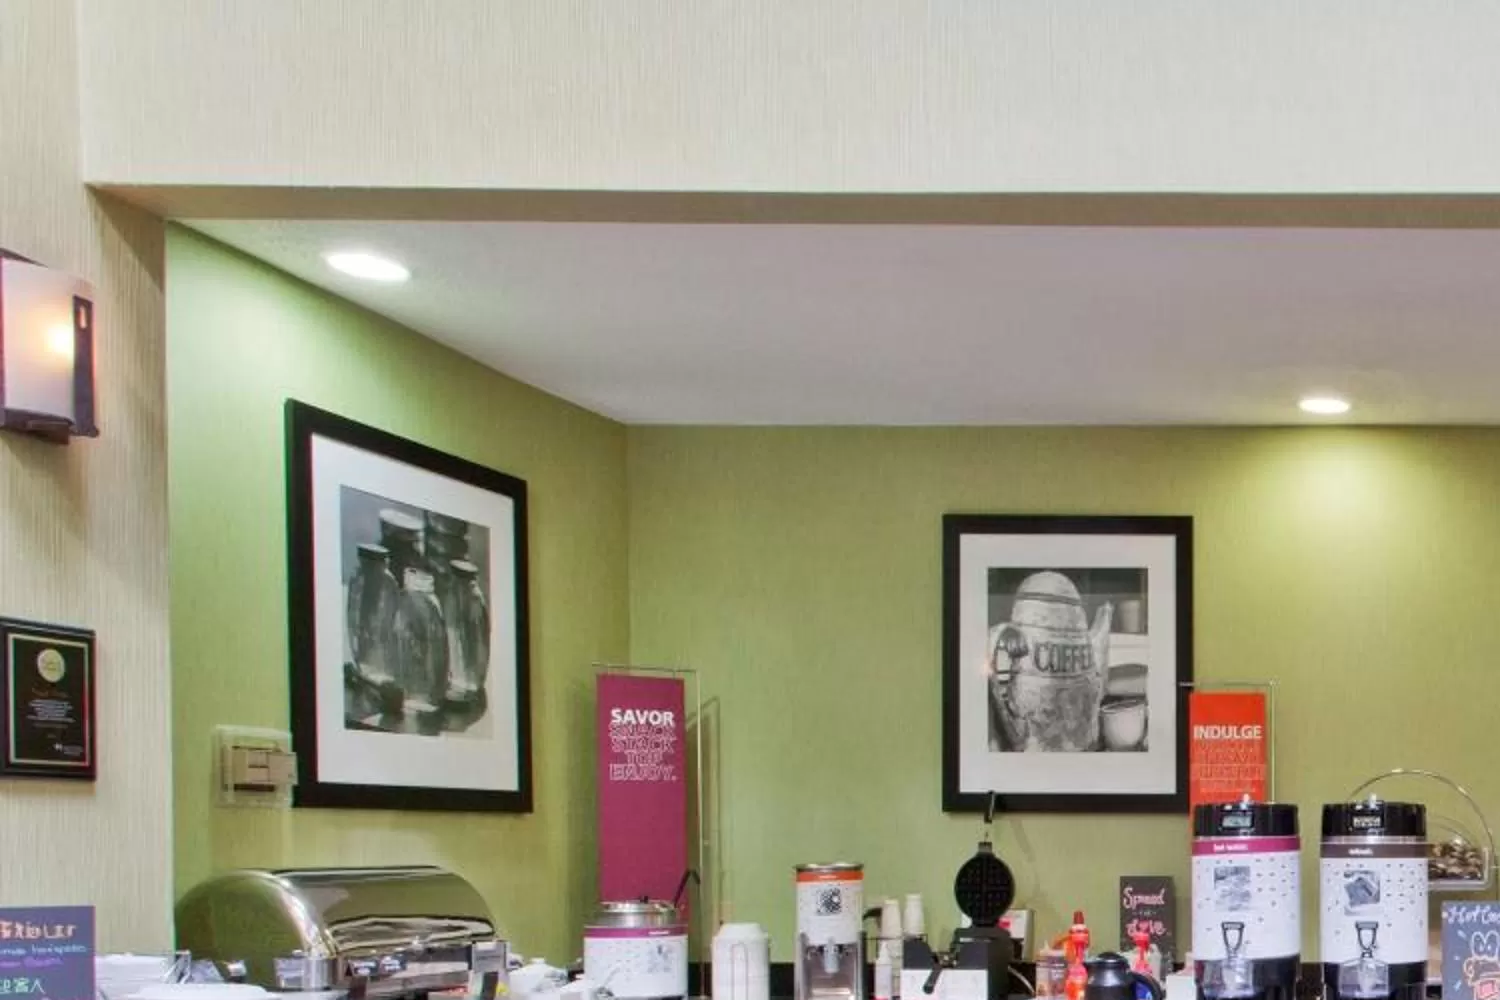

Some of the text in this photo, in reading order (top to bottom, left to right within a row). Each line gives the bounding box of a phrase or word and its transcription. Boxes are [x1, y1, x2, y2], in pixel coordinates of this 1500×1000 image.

[610, 708, 675, 726] SAVOR
[1193, 725, 1263, 740] INDULGE
[1447, 905, 1481, 925] Hot
